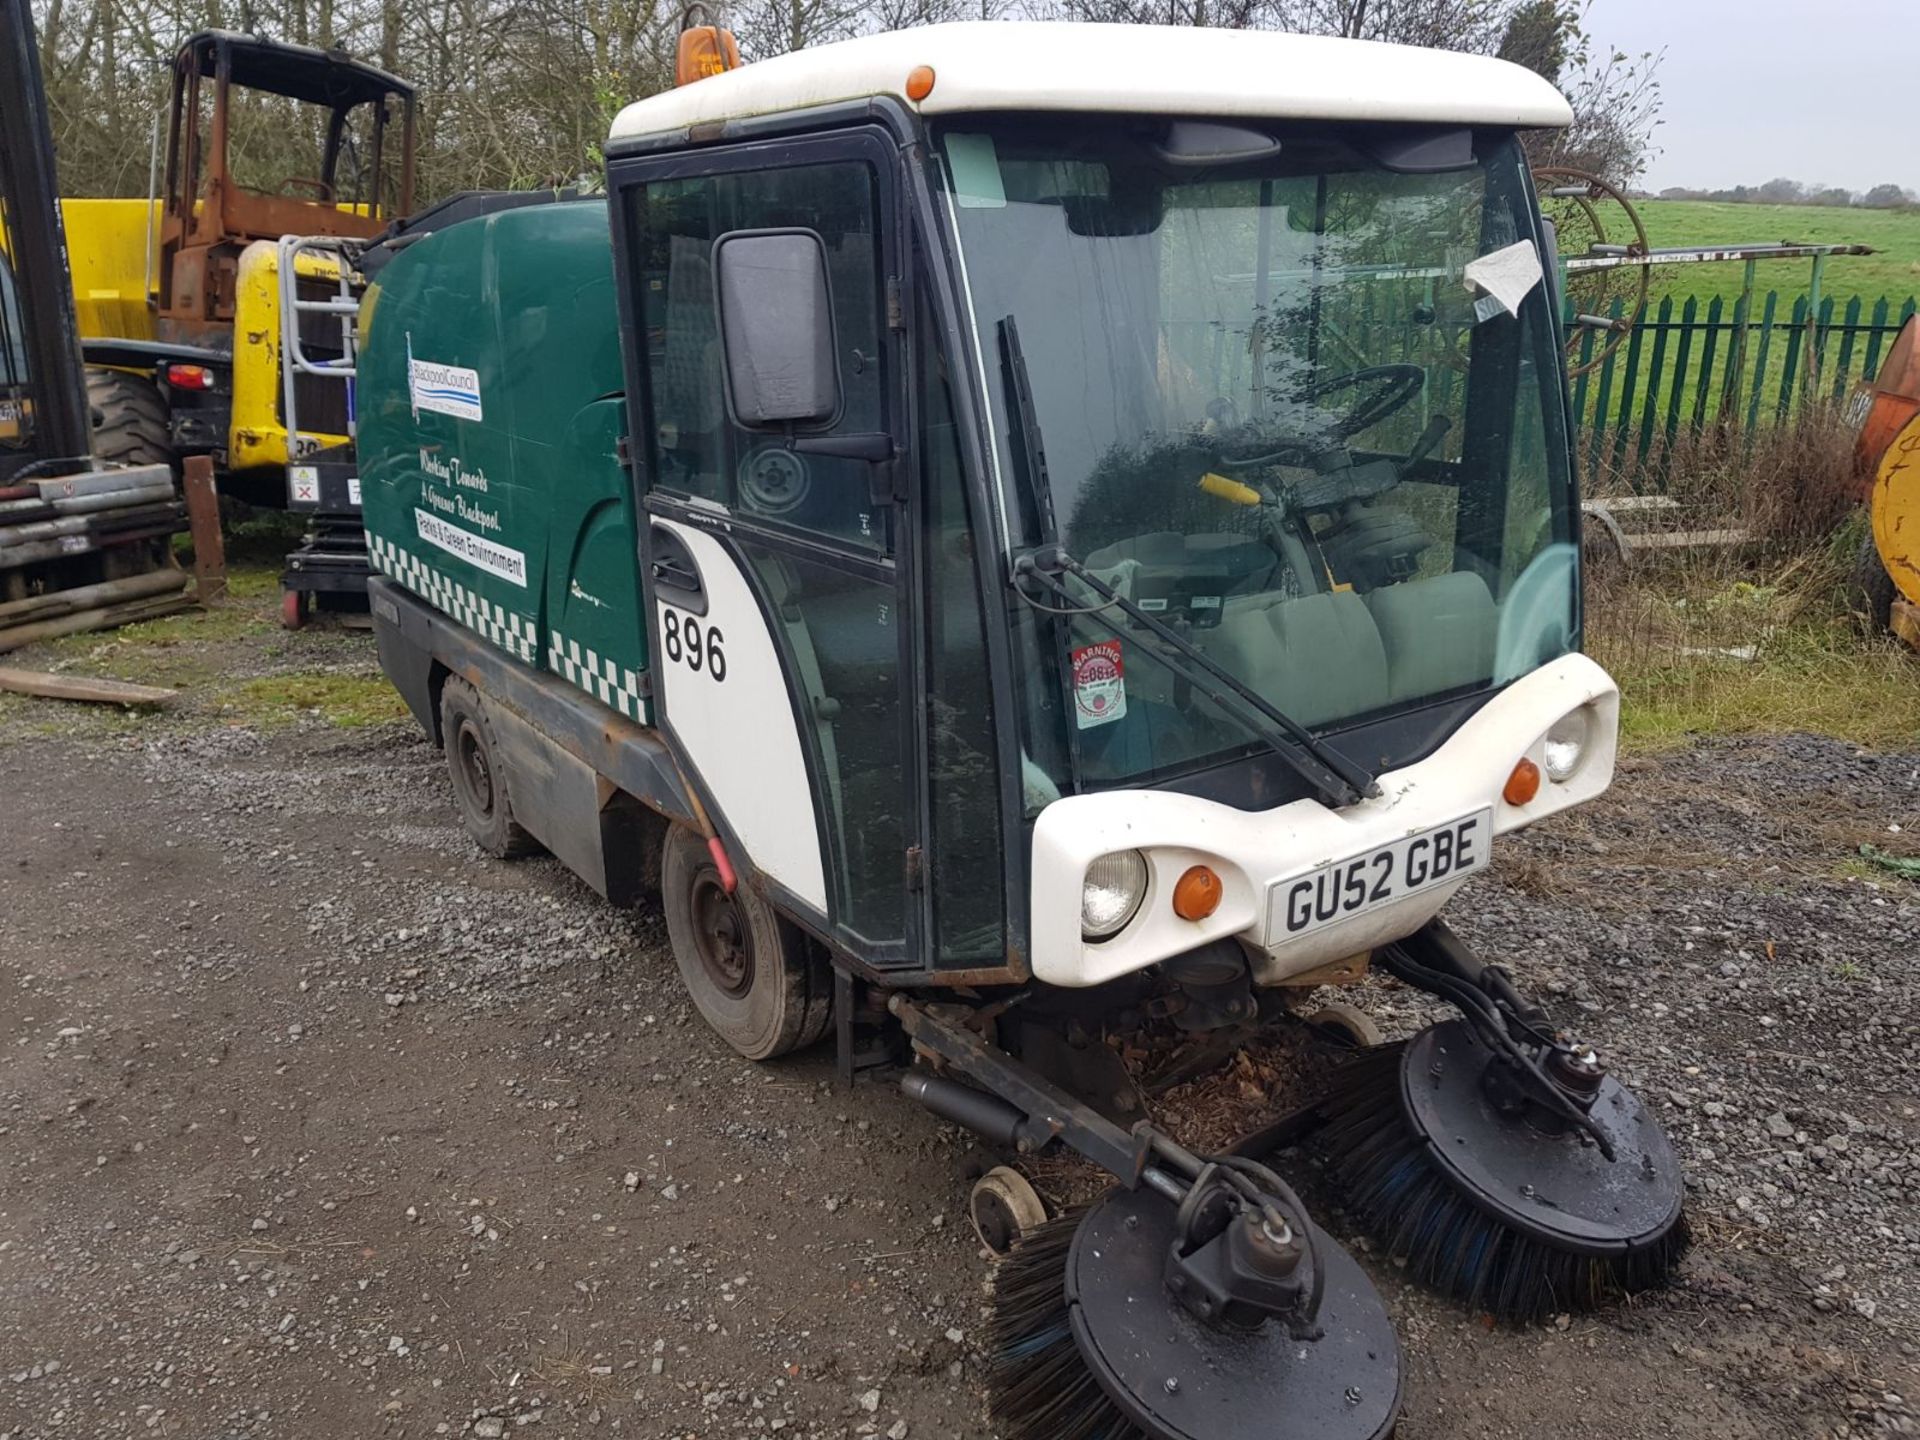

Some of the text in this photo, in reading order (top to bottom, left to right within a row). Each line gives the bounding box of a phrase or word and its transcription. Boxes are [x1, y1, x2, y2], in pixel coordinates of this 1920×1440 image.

[420, 449, 488, 492] Working Towards
[421, 480, 428, 505] A
[428, 485, 455, 514] Greener
[418, 512, 523, 578] Parks & Green Environment
[664, 608, 727, 683] 896
[1073, 645, 1121, 671] WARNING
[1286, 818, 1478, 932] GU52 GBE
